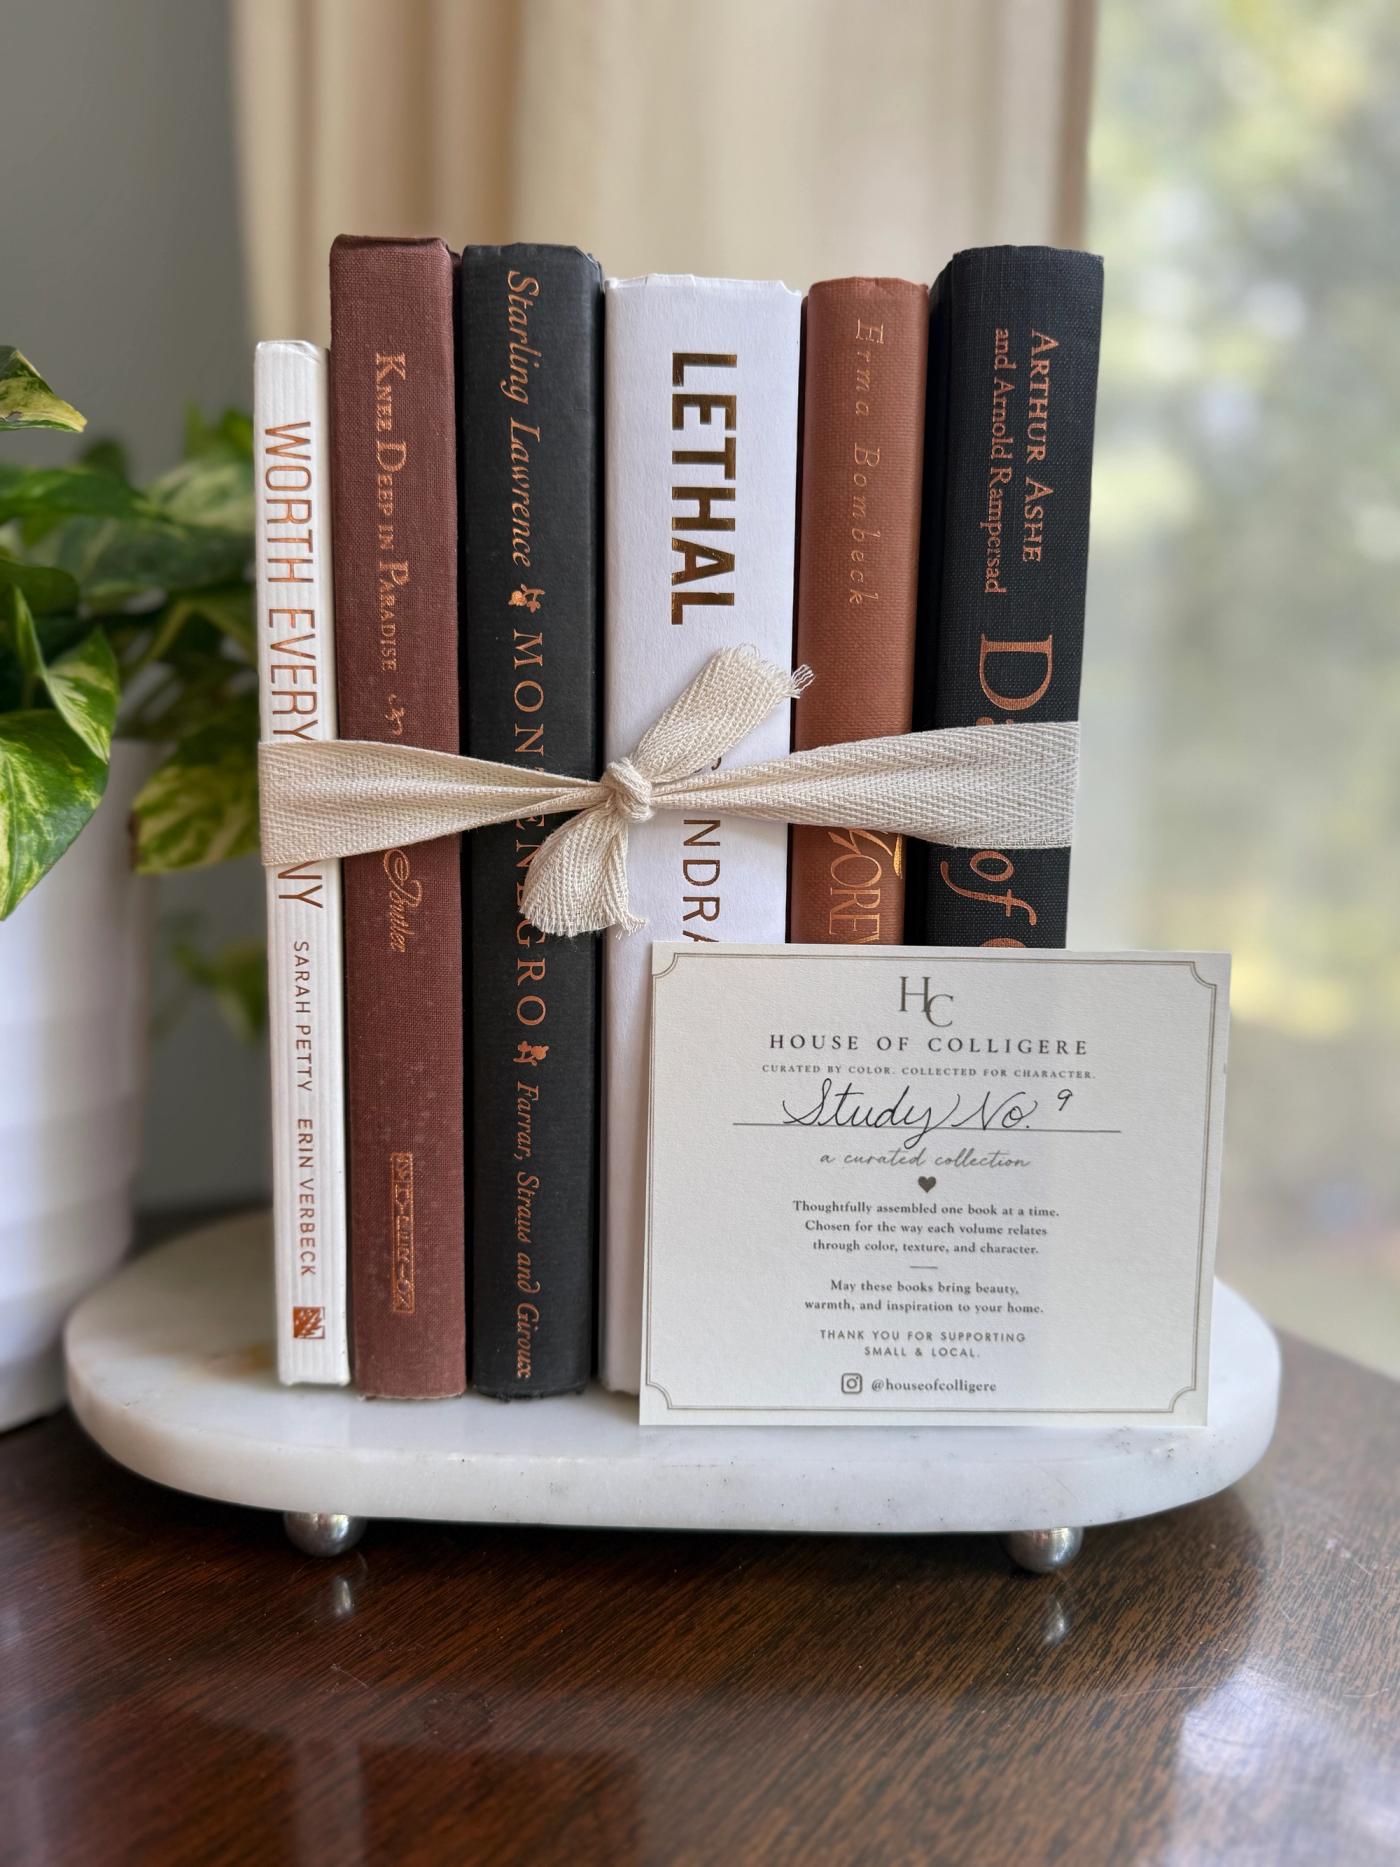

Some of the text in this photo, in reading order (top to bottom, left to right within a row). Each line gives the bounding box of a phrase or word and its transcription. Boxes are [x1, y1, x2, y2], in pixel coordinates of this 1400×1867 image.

[499, 271, 541, 567] Starling Lawrence
[848, 320, 883, 607] Erma Bombeck
[979, 328, 1014, 593] and Arnold Rampersad
[1021, 330, 1059, 562] ARTHUR ASHE
[265, 421, 314, 584] WORTH
[375, 352, 409, 671] KNEE DEEP IN PARADISE
[671, 352, 737, 626] LETHAL
[268, 608, 318, 740] EVERY
[511, 630, 546, 1025] MONENGRO
[383, 849, 423, 952] Butler
[940, 851, 1037, 926] of
[294, 941, 313, 1092] SARAH PETTY
[769, 1034, 1089, 1055] HOUSE OF COLLIGERE
[762, 1064, 1096, 1079] CURATED BY COLOR. COLLECTED FOR CHARACTER.
[782, 1078, 1073, 1150] Study No. 9
[297, 1119, 316, 1276] ERIN VERBECK
[820, 1148, 1031, 1169] a curated collection
[513, 1081, 540, 1380] Farrar, Straus and Giroux
[793, 1200, 1059, 1217] Thoughtfully assembled one book at a time.
[805, 1219, 1048, 1236] Chosen for the way each volume relates
[813, 1239, 1039, 1255] through color, texture, and character.
[805, 1299, 1044, 1317] warmth, and inspiration to your home.
[830, 1280, 1019, 1297] May these books bring beauty,
[820, 1329, 1026, 1343] THANK YOU FOR SUPPORTING
[864, 1346, 980, 1358] SMALL & LOCAL.
[871, 1378, 997, 1394] @houseofcolligere
